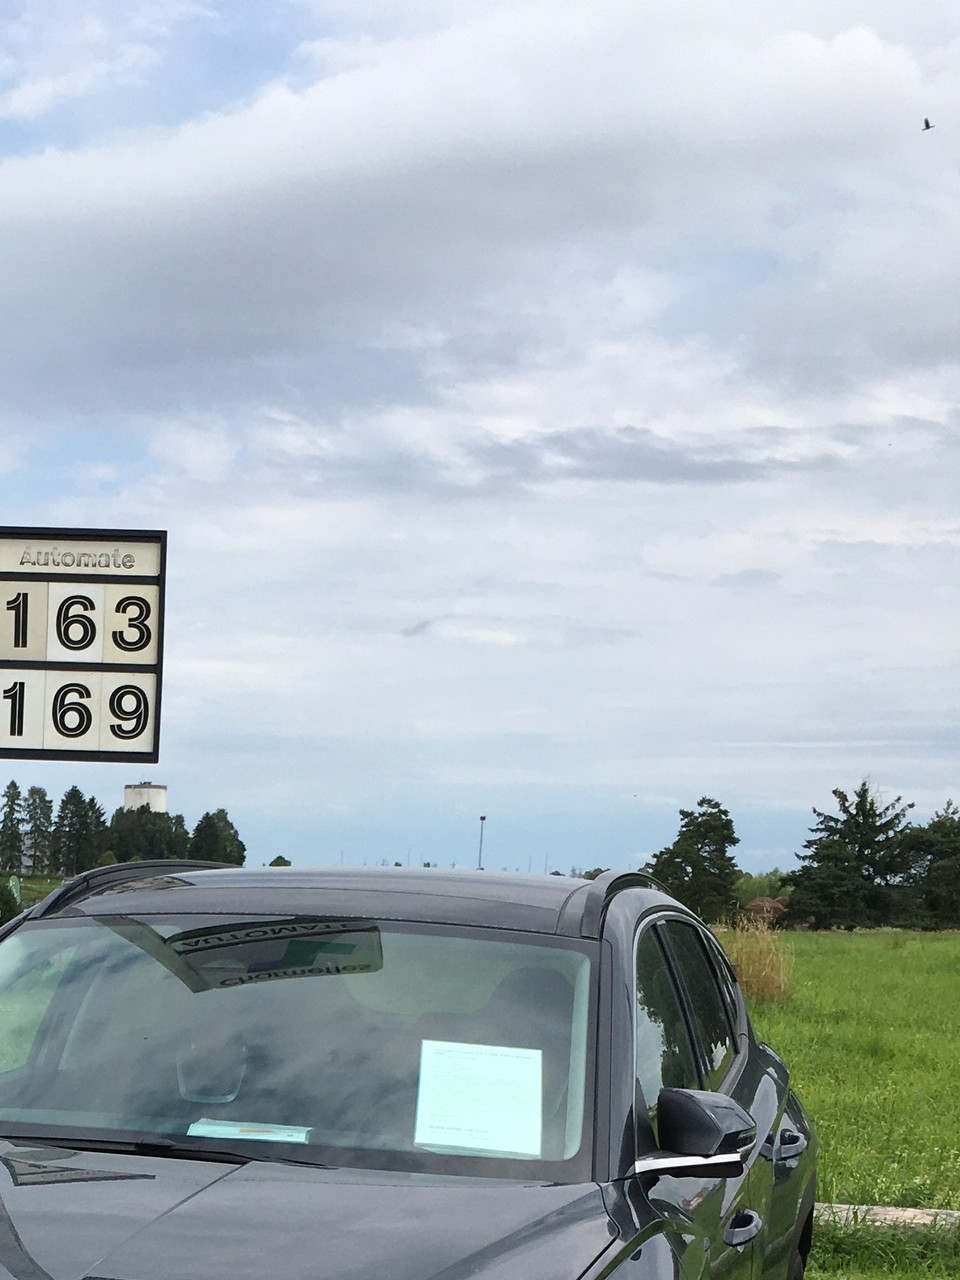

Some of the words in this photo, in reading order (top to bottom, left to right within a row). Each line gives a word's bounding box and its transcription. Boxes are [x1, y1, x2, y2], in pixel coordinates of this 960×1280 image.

[19, 545, 136, 570] Automate
[6, 592, 152, 652] 163
[2, 681, 150, 740] 169
